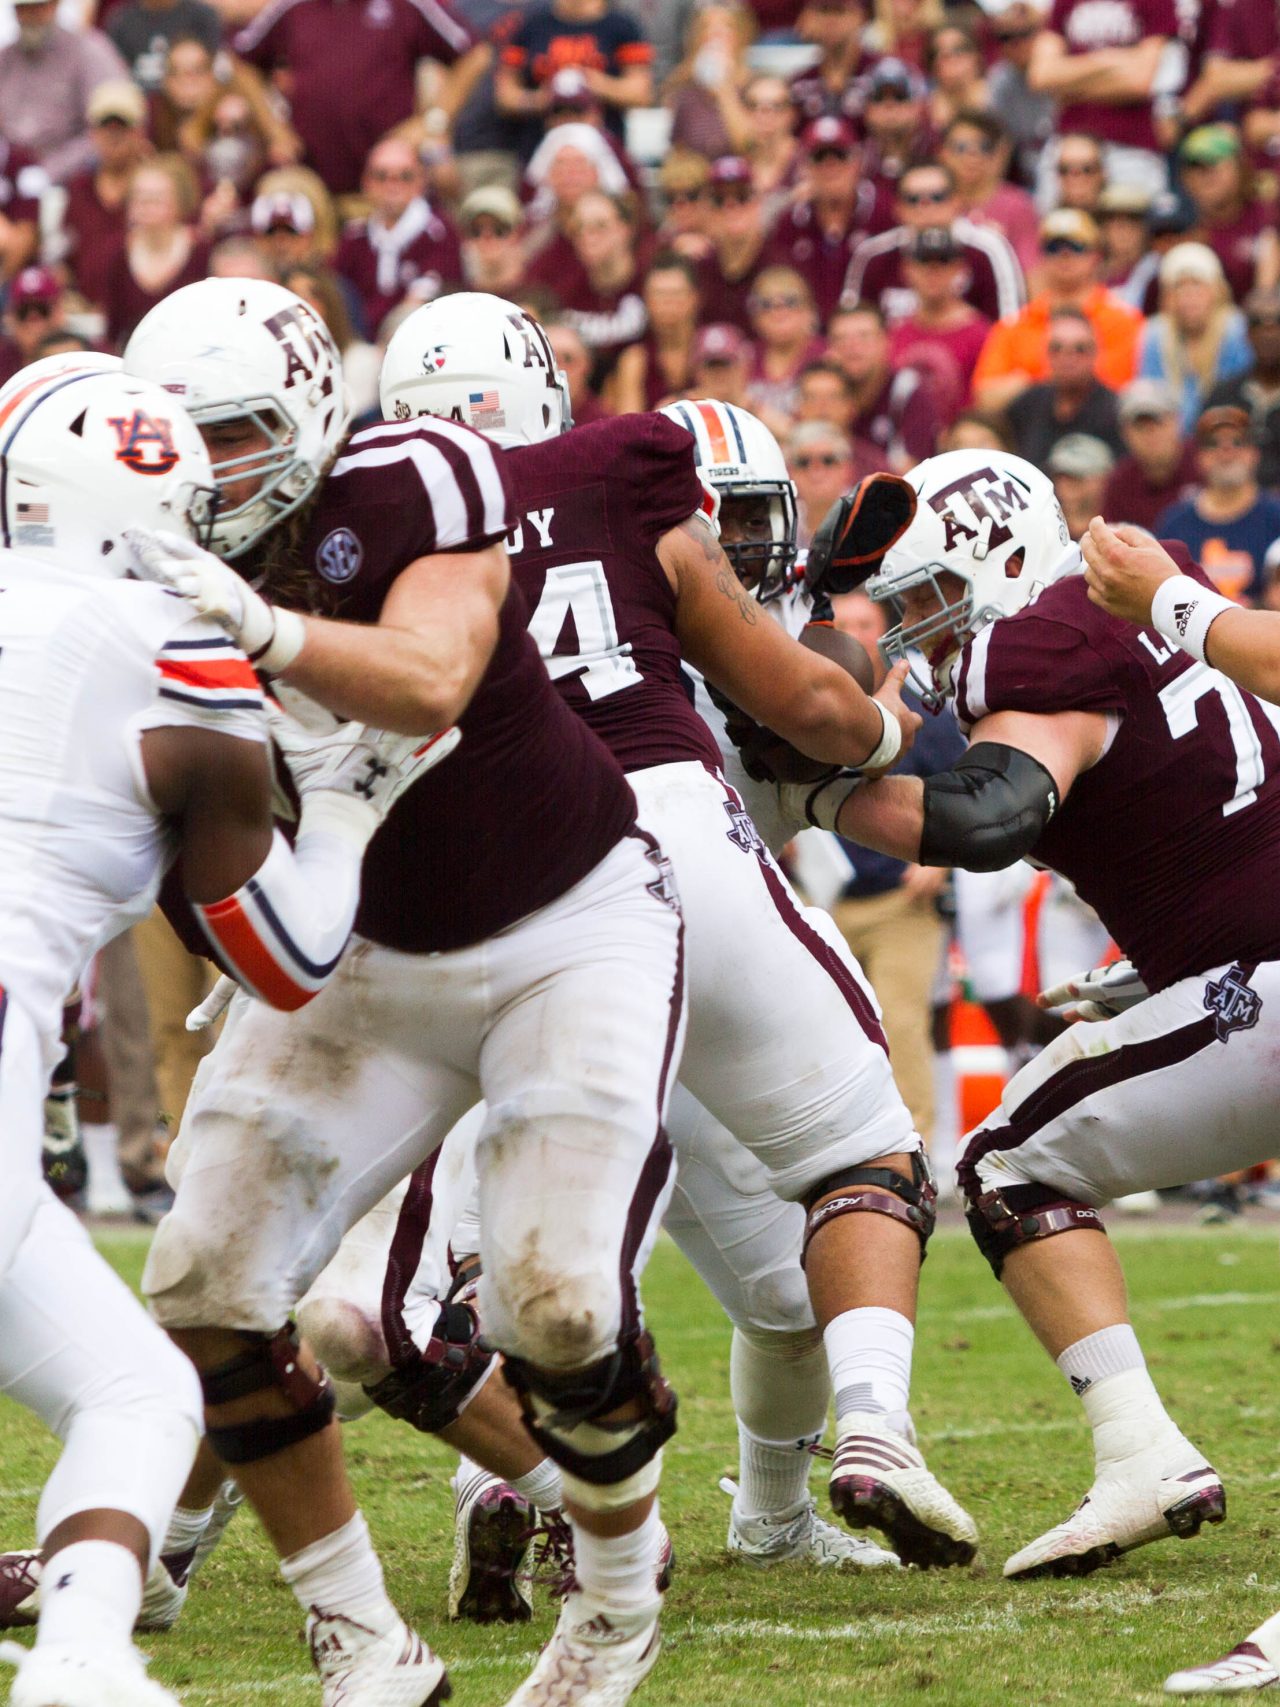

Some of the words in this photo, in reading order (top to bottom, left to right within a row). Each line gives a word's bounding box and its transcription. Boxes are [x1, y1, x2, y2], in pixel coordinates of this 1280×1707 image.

[708, 467, 739, 478] TIGERS
[320, 531, 362, 579] SEC
[1179, 600, 1199, 637] adidas
